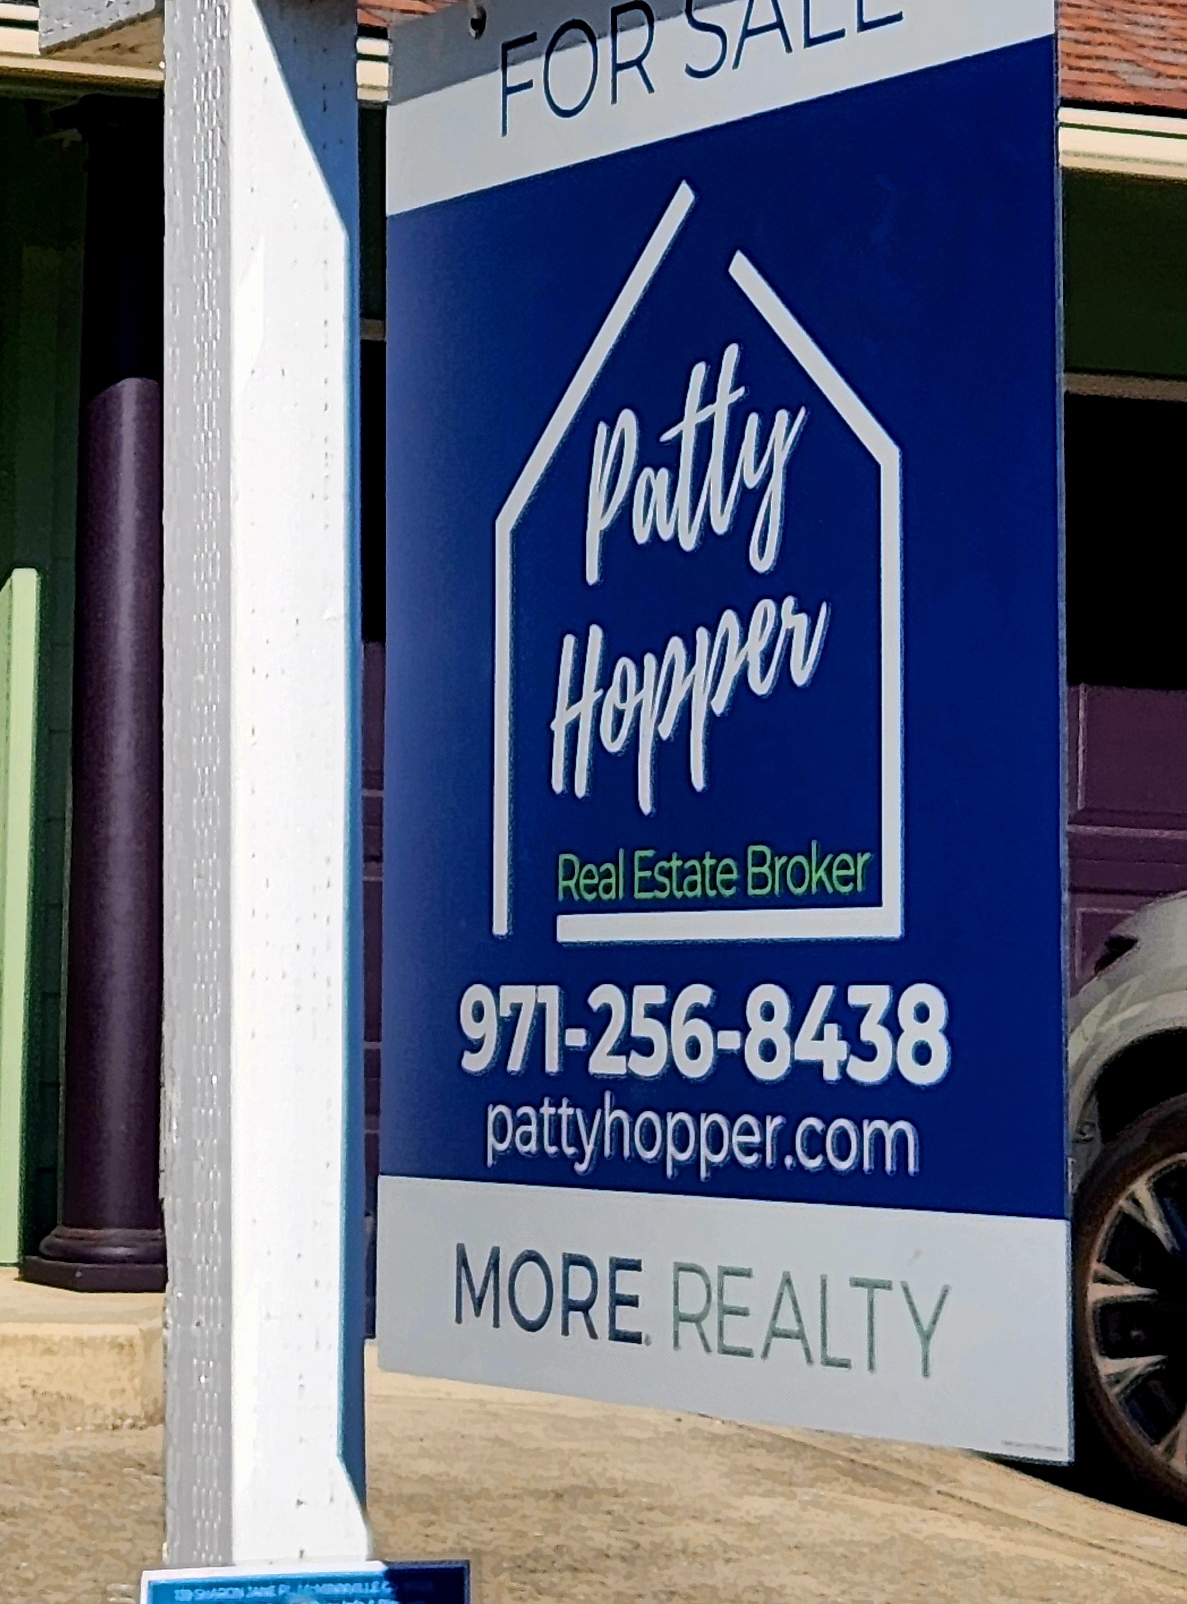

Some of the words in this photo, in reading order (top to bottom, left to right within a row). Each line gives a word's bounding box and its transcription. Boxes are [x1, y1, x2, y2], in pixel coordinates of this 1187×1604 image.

[501, 0, 656, 138] FOR
[585, 342, 808, 586] Patty
[550, 596, 828, 816] Hopper
[558, 848, 624, 901] Real
[634, 848, 738, 899] Estate
[747, 839, 871, 896] Broker
[459, 982, 950, 1086] 971-256-8438
[485, 1090, 918, 1179] pattyhopper.com
[454, 1242, 643, 1345] MORE
[672, 1261, 950, 1379] REALTY
